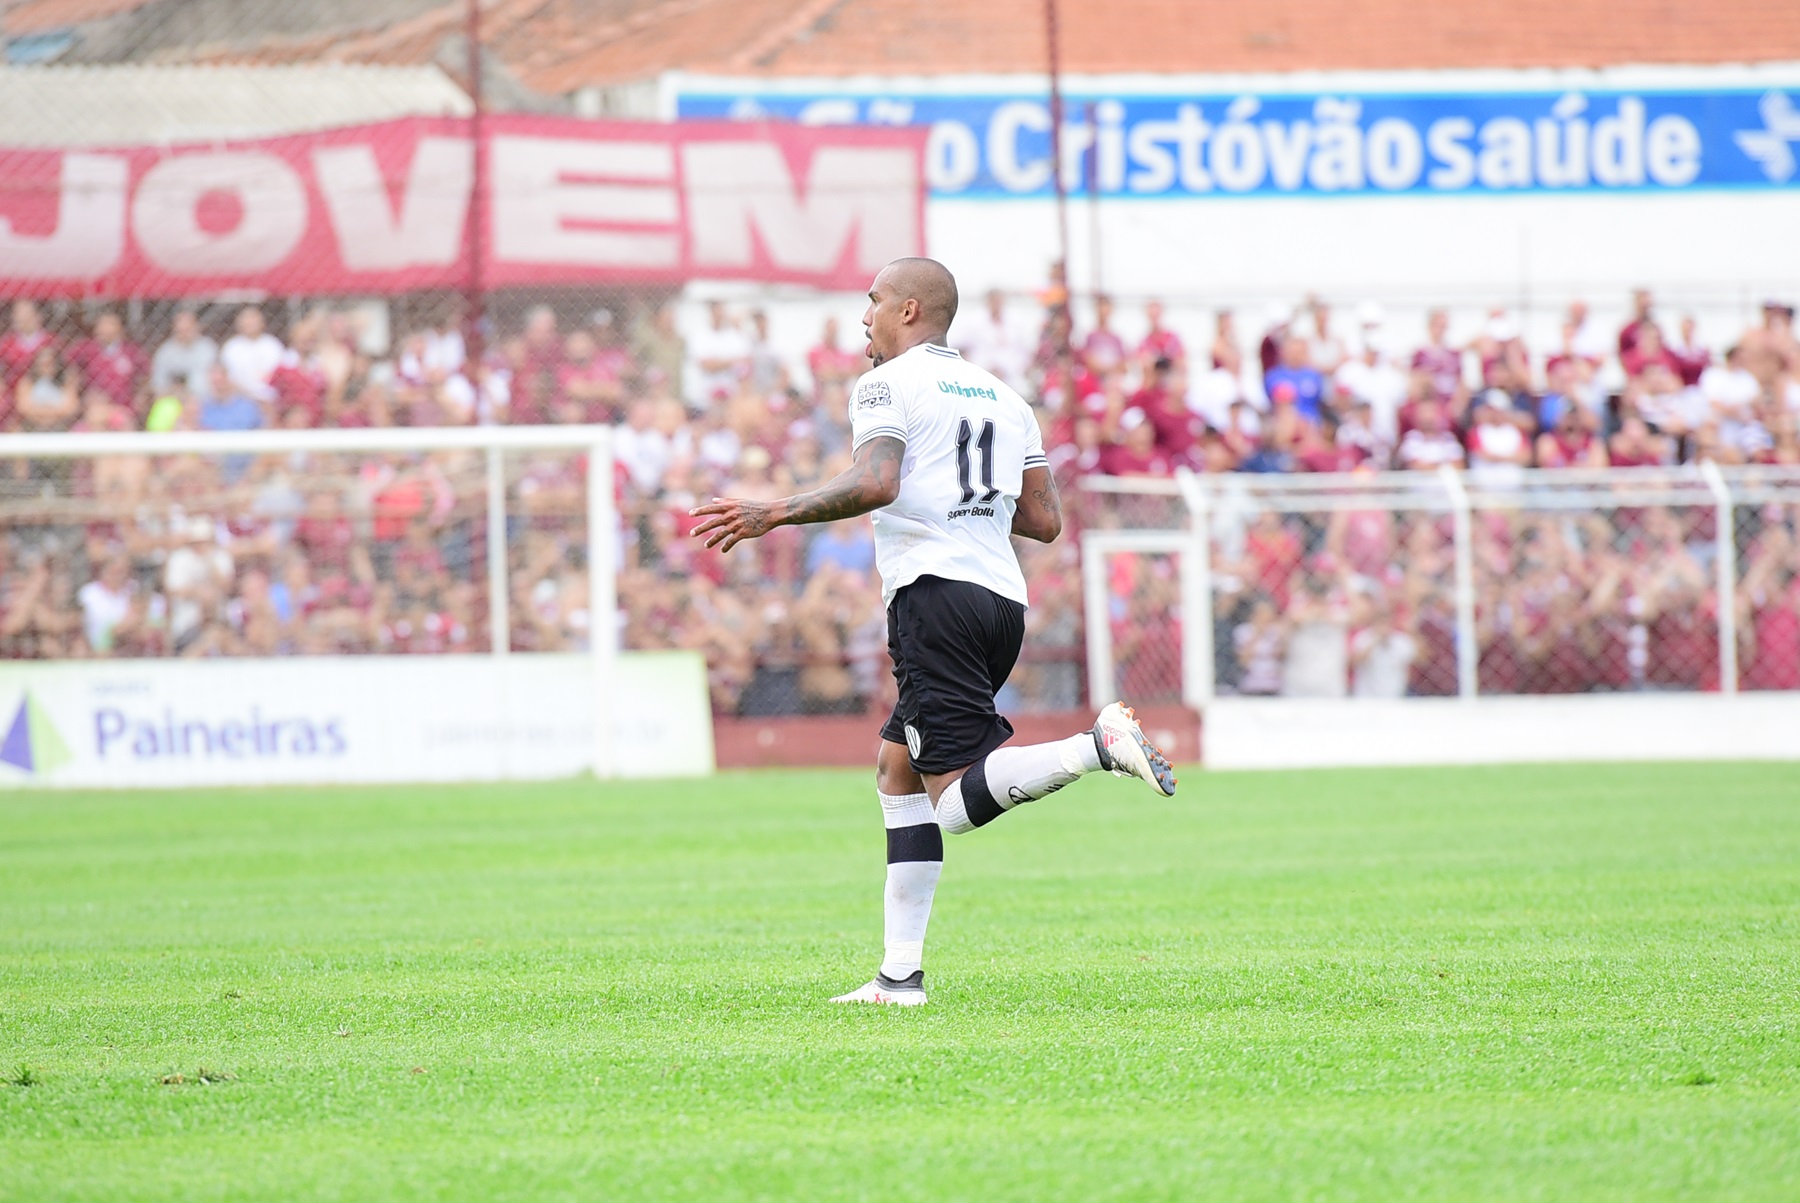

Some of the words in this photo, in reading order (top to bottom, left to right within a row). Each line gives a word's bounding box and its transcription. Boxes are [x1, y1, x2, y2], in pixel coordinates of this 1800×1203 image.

[985, 93, 1424, 192] Cristóvão
[1426, 90, 1702, 189] saúde
[0, 134, 918, 280] JOVEM
[937, 380, 998, 401] Unimed
[955, 417, 1000, 506] 11
[94, 705, 346, 758] Paineiras
